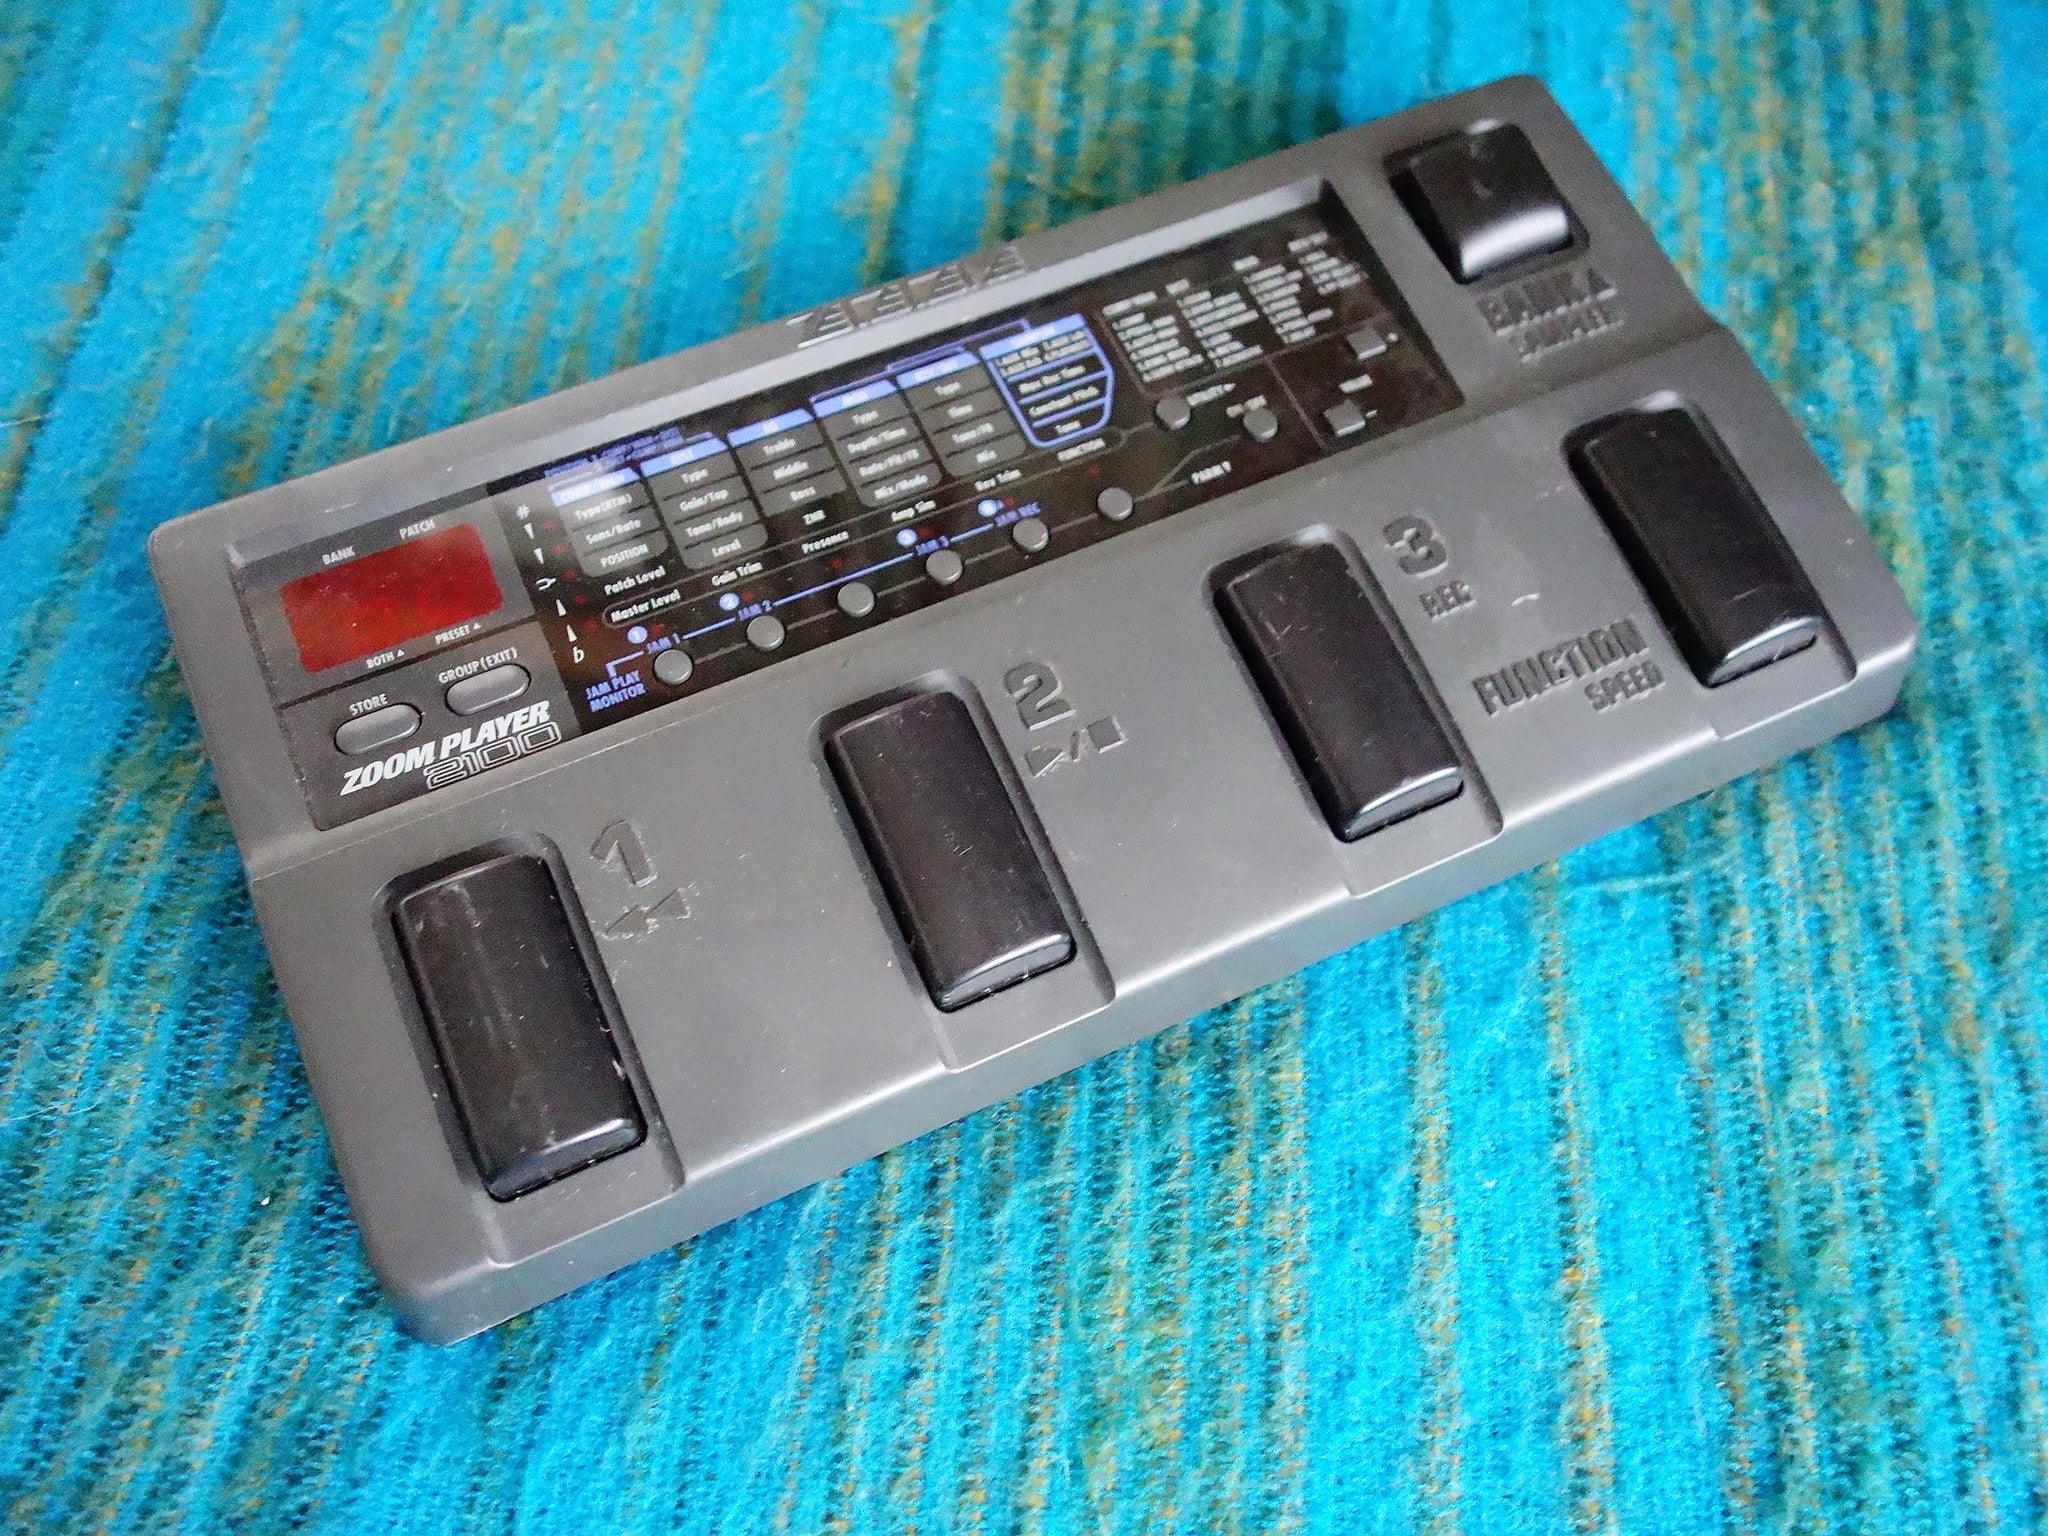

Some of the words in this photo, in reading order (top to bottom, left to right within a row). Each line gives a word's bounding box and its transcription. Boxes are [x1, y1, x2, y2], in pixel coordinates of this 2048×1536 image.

[681, 468, 708, 485] Type
[400, 520, 435, 539] PATCH
[585, 519, 641, 544] Sens/Rate
[802, 531, 849, 554] Presence
[322, 546, 355, 565] BANK
[601, 543, 648, 568] POSITION
[712, 538, 742, 558] Level
[1383, 514, 1449, 579] 3
[604, 576, 635, 596] Patch
[636, 566, 666, 585] Level
[711, 569, 737, 587] Gain
[737, 561, 763, 578] Trim
[611, 602, 650, 623] Master
[651, 589, 681, 609] Level
[738, 603, 762, 622] JAM
[761, 599, 773, 613] 2
[1418, 579, 1476, 622] REC
[434, 625, 470, 645] PRESET
[647, 636, 672, 654] JAM
[671, 632, 681, 645] 1
[366, 651, 395, 669] BOTH
[438, 647, 518, 684] GROUP(EXIT)
[1472, 616, 1649, 718] FUNCTION
[585, 680, 611, 700] JAM
[610, 670, 641, 690] PLAY
[590, 683, 646, 713] MONITOR
[1003, 660, 1076, 731] 2
[1584, 660, 1666, 713] SPEED
[350, 694, 388, 716] STORE
[340, 745, 437, 797] ZOOM
[440, 700, 551, 759] PLAYER
[423, 721, 561, 790] 2100
[590, 819, 657, 888] 1
